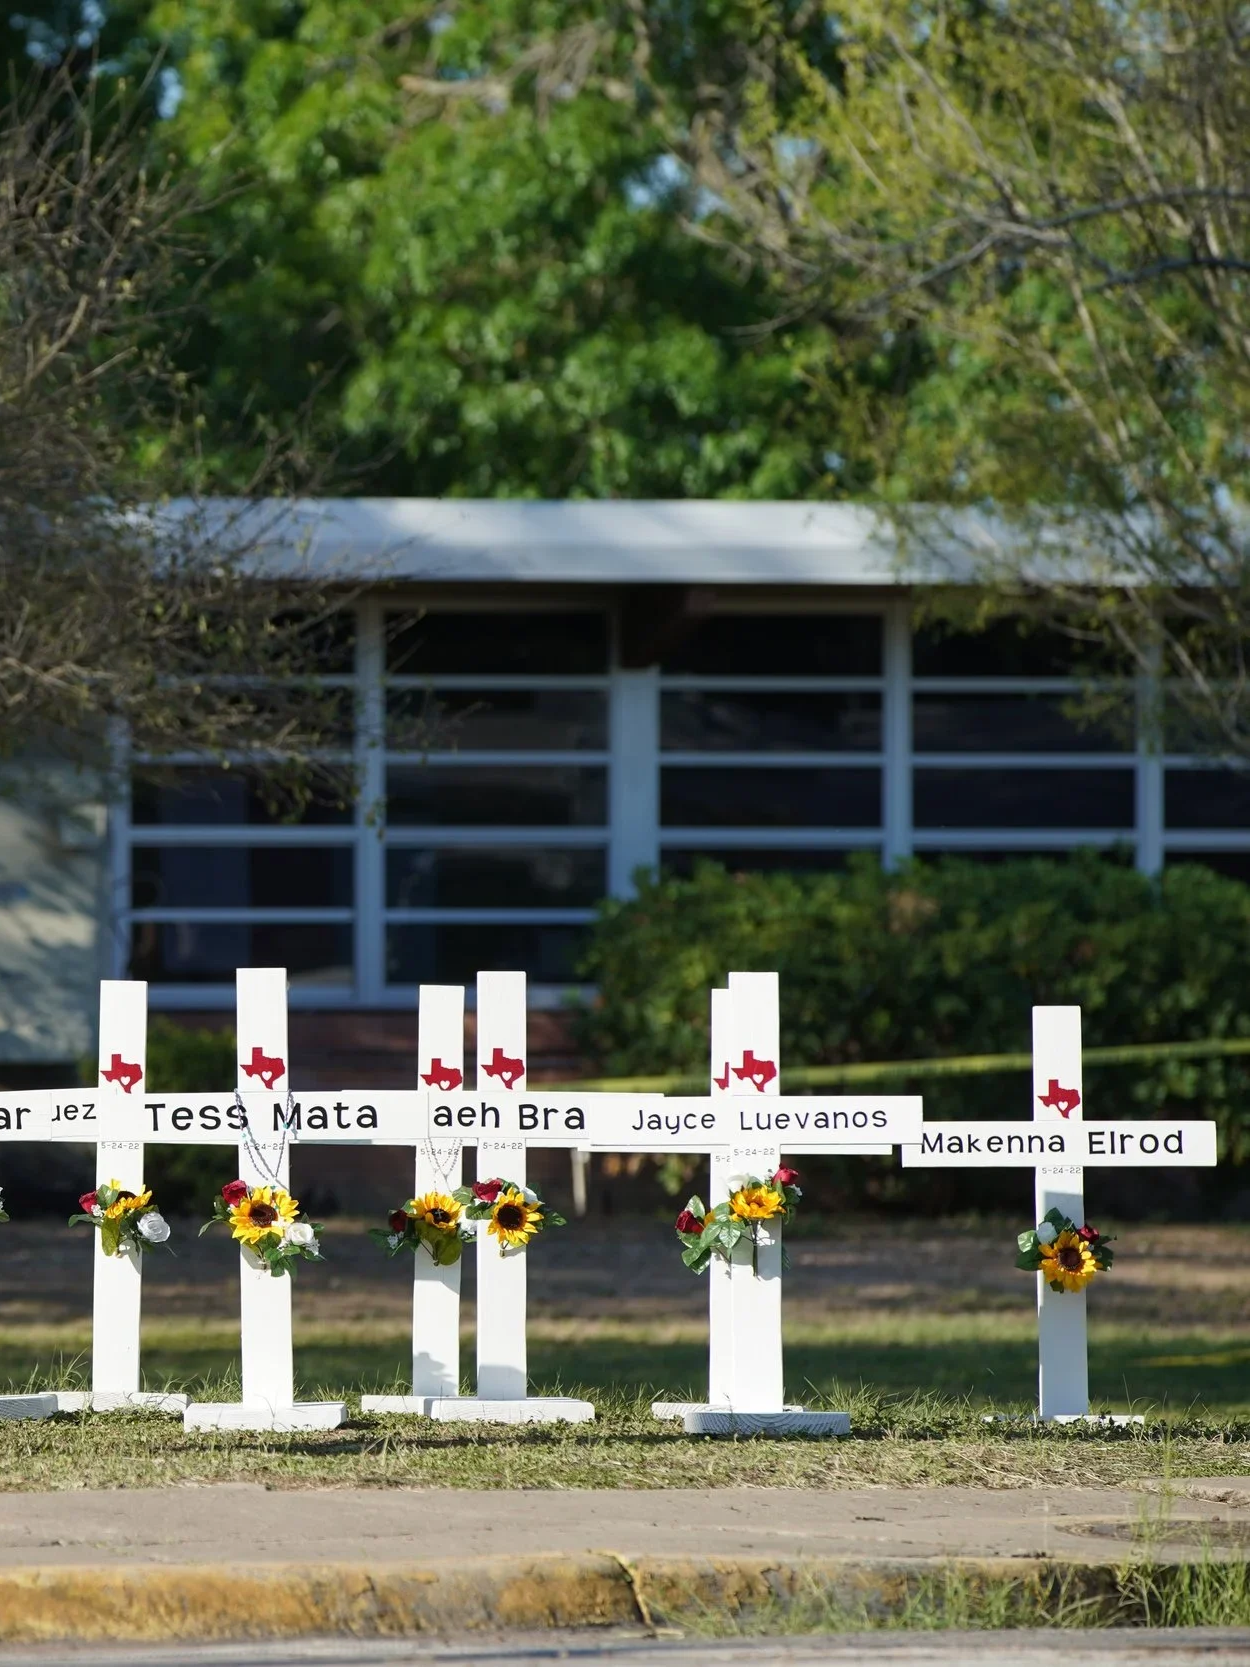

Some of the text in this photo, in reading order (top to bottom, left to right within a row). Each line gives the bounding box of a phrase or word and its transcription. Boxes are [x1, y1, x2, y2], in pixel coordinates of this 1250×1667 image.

[144, 1102, 378, 1132] Tess Mata
[433, 1102, 585, 1131] aeh Bra
[631, 1109, 888, 1135] Jayce Luevanos
[101, 1142, 140, 1150] 5-24-22
[482, 1141, 523, 1150] 5-24-22
[920, 1130, 1183, 1155] Makenna Elrod
[733, 1147, 775, 1156] 5-24-22
[1041, 1166, 1081, 1175] 5-24-22
